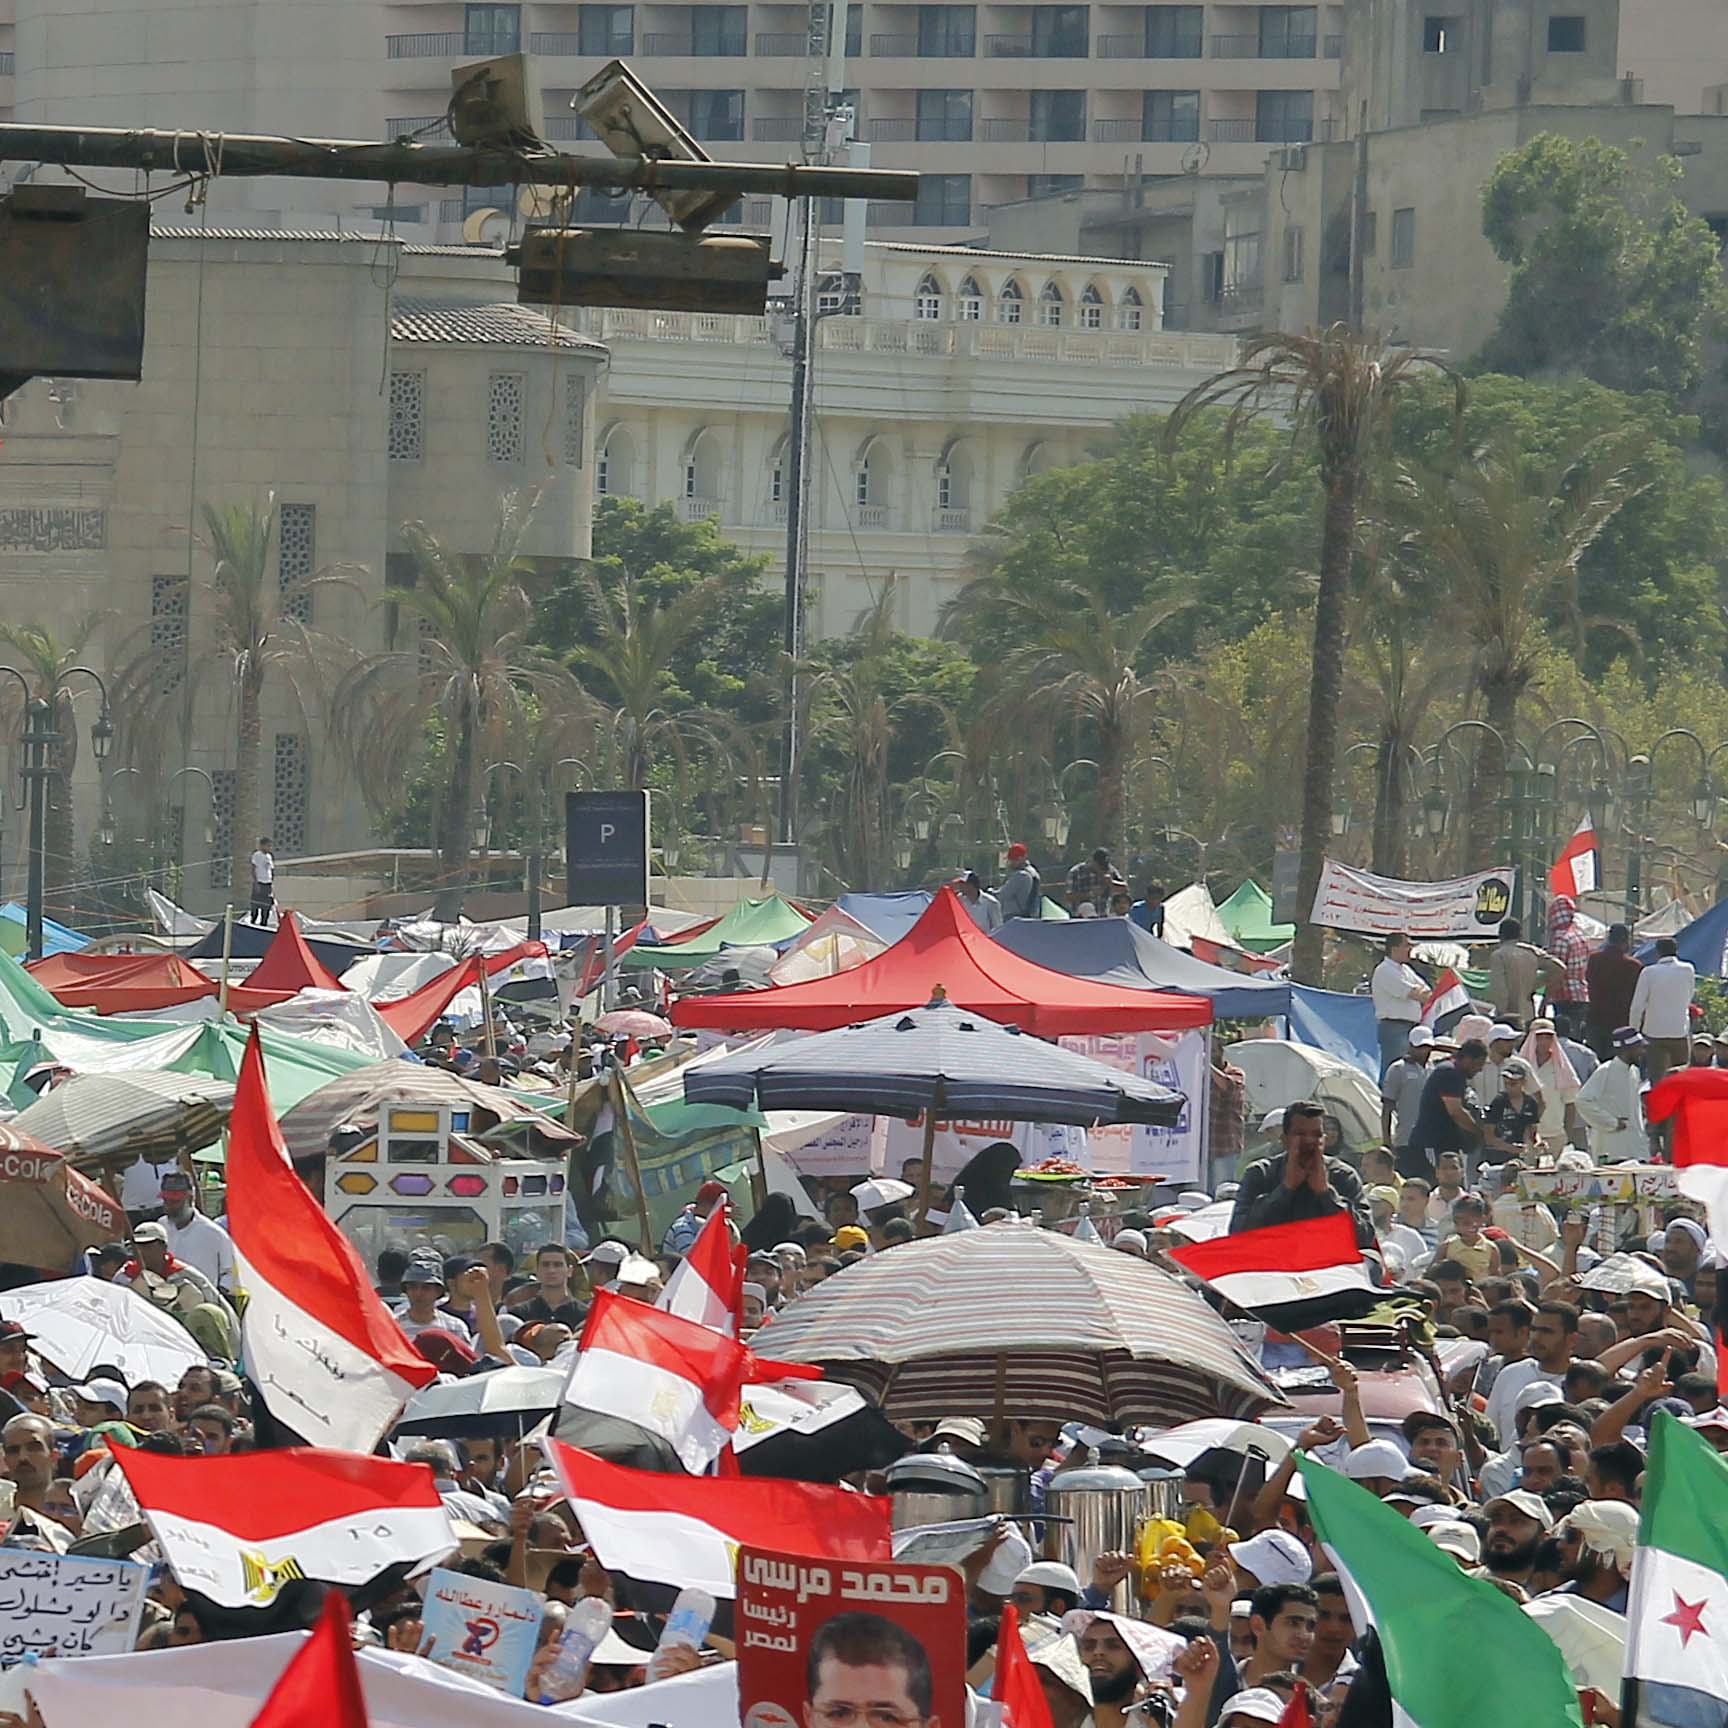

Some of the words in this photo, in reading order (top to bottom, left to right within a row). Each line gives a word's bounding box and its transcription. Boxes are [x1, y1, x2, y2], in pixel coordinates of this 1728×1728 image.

[600, 823, 616, 844] P
[117, 1565, 132, 1592] يا
[743, 1555, 833, 1604] مرسى
[840, 1567, 949, 1605] محمد
[62, 1625, 104, 1652] كان
[742, 1628, 799, 1653] لمصر
